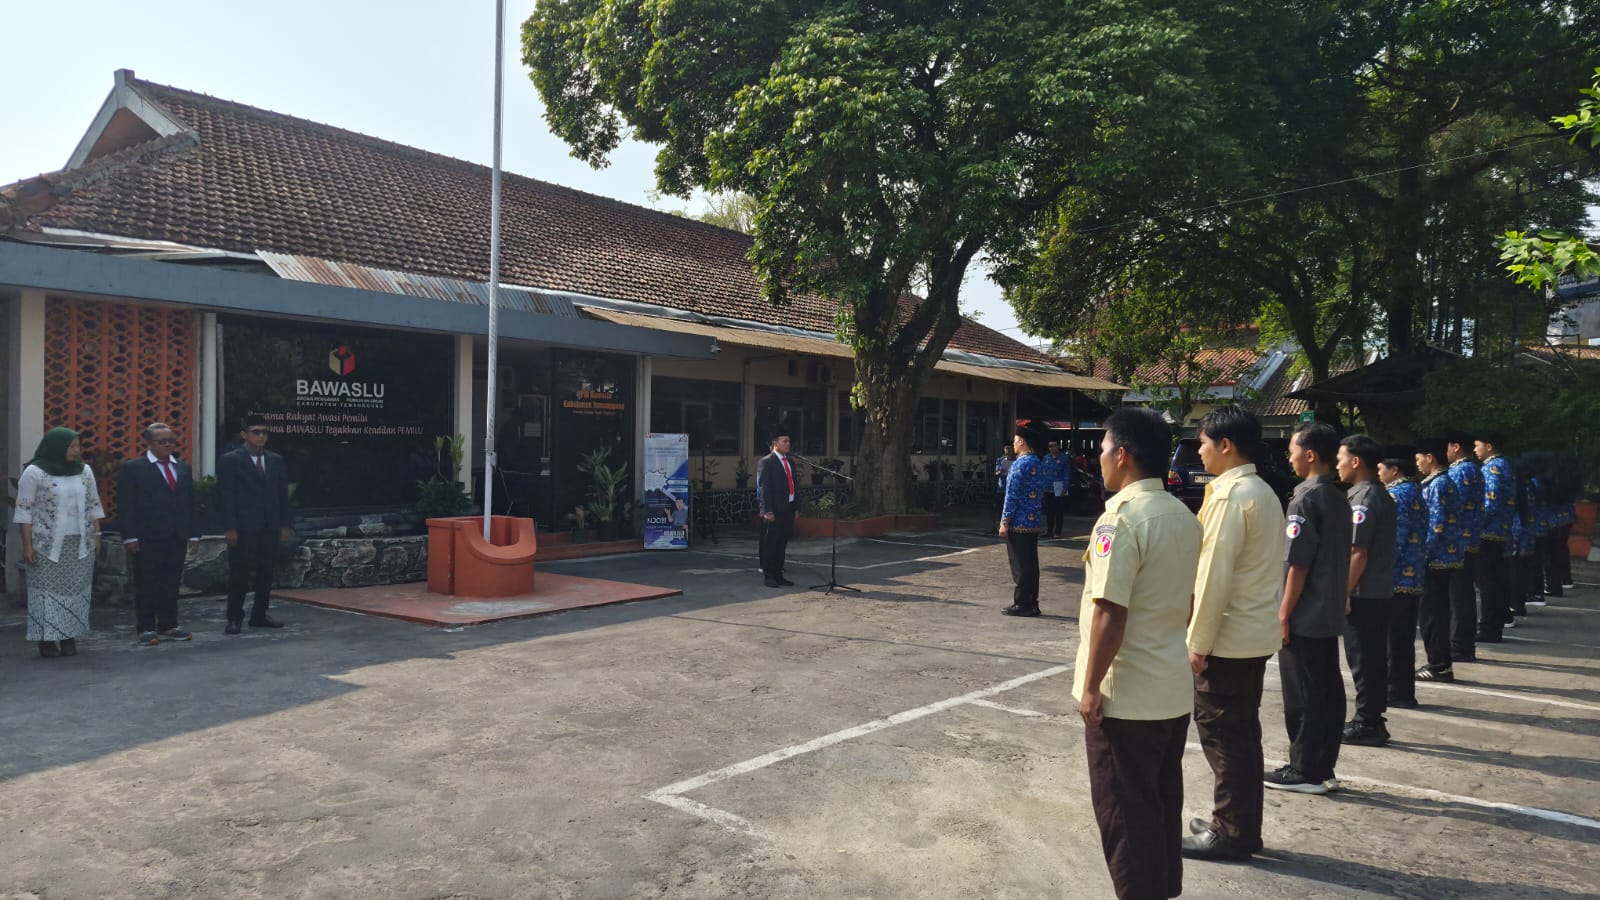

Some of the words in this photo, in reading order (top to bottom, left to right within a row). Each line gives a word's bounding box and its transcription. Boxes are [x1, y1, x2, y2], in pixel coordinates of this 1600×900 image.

[296, 380, 385, 398] BAWASLU
[286, 412, 316, 423] Rakyat
[319, 412, 340, 422] Awasi
[342, 413, 368, 422] Pemilu
[286, 424, 323, 434] BAWASLU
[325, 425, 361, 437] Tegakkan
[364, 425, 396, 435] Keadilan
[397, 426, 424, 435] PEMILU
